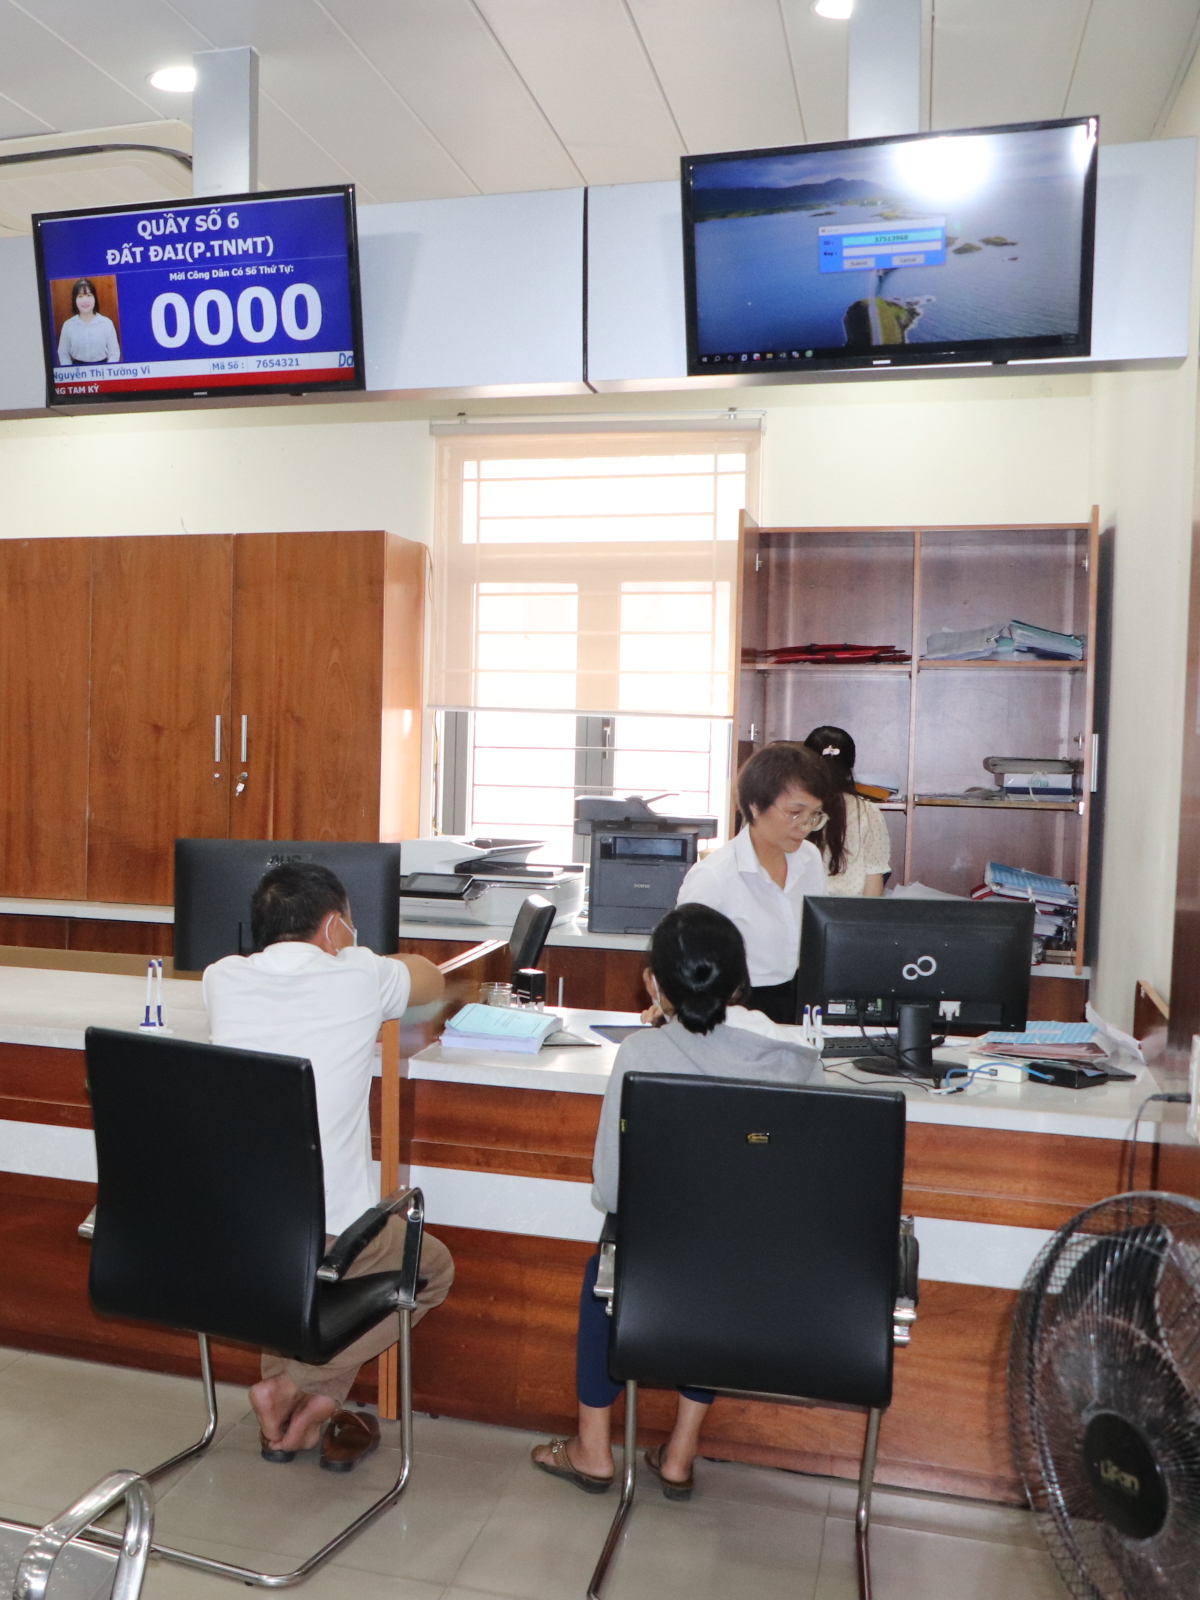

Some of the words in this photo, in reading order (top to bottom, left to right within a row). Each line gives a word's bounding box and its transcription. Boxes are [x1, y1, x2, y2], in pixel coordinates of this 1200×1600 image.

[137, 213, 190, 240] QUẦY
[195, 208, 221, 232] SỐ
[227, 212, 240, 229] 6
[106, 243, 144, 266] ĐẤT
[148, 235, 274, 263] ĐAI(P.TNMT)
[169, 272, 186, 281] Mời
[187, 270, 210, 280] Công
[212, 269, 230, 278] Dân
[232, 266, 243, 276] Có
[245, 265, 257, 275] Số
[259, 265, 277, 274] Thứ
[279, 264, 294, 274] Tự:
[151, 283, 322, 348] 0000
[212, 362, 225, 370] Mã
[256, 357, 300, 369] 7654321
[89, 368, 104, 379] Thị
[107, 367, 138, 377] Tường
[68, 386, 86, 394] TAM
[87, 383, 99, 394] KỲ
